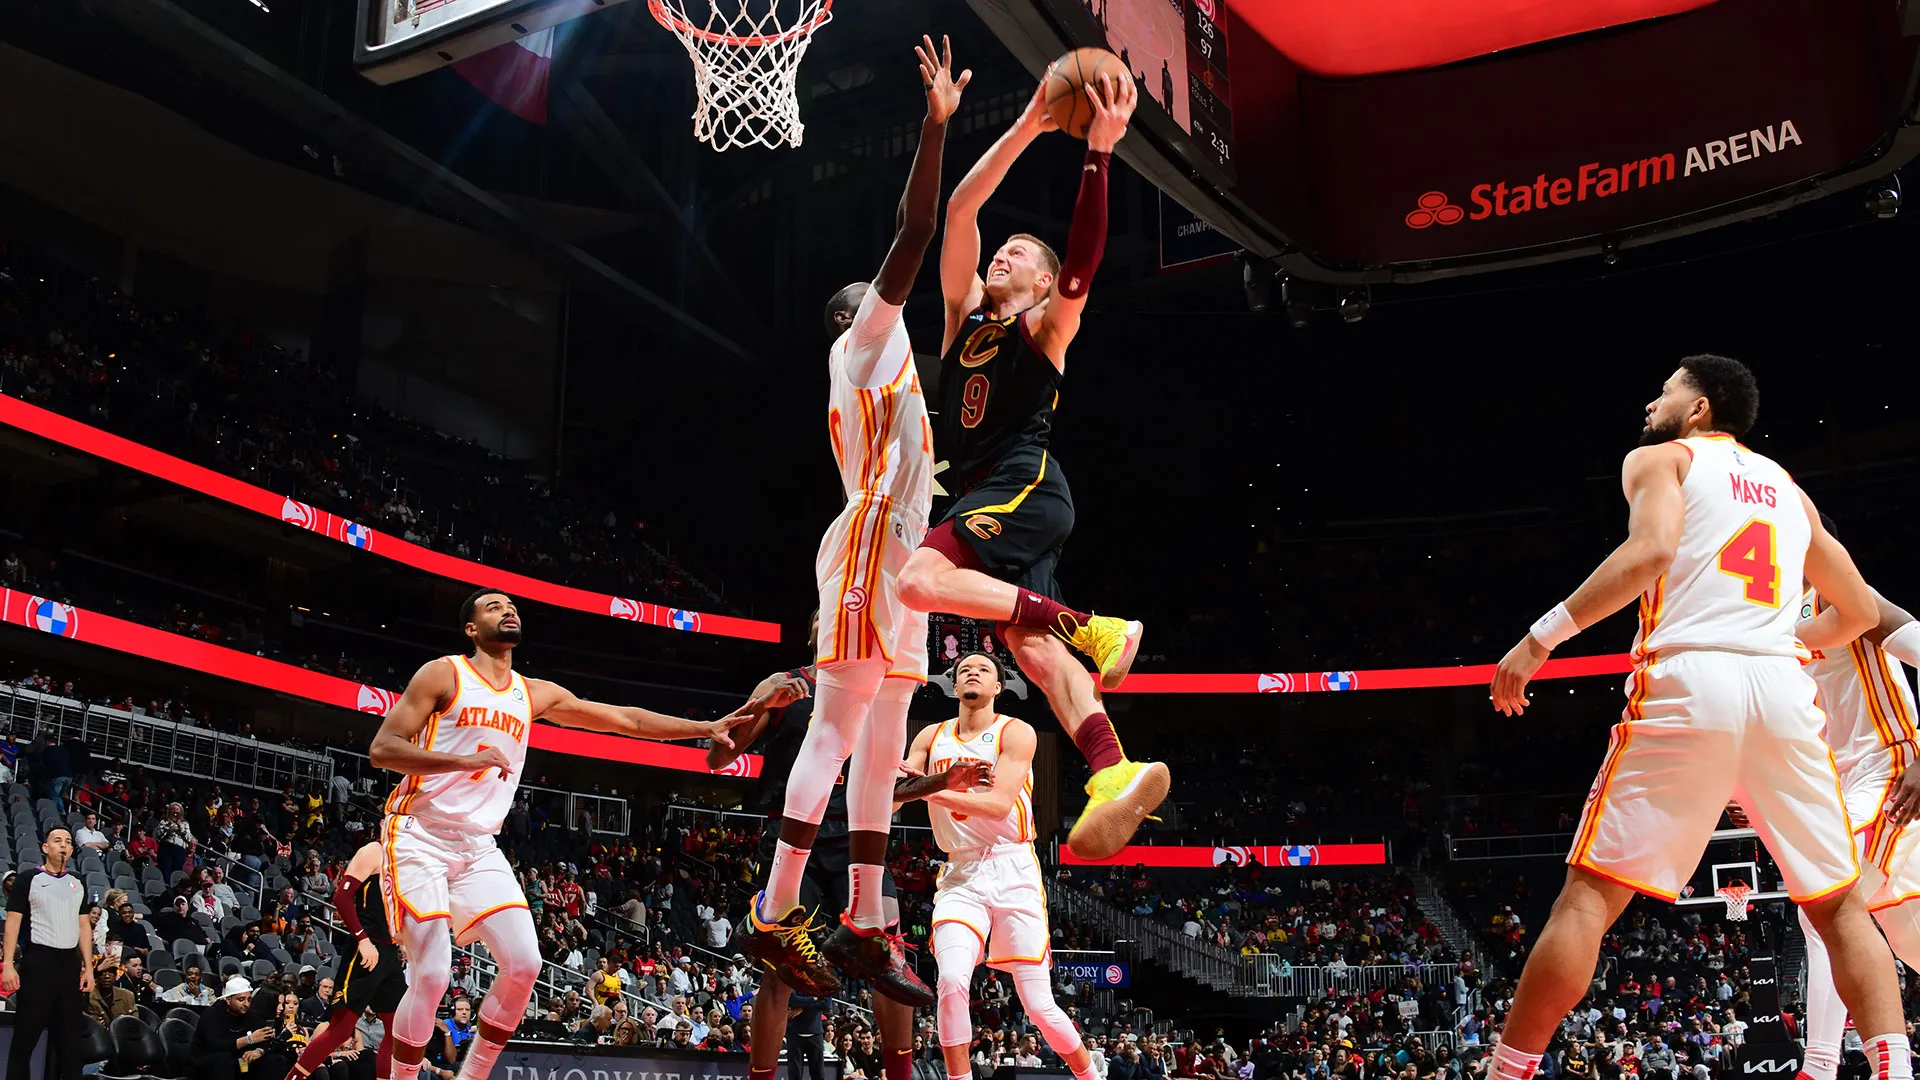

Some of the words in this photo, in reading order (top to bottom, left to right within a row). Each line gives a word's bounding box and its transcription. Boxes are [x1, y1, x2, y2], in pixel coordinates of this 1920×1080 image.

[1198, 12, 1214, 39] 126
[1200, 38, 1212, 58] 97
[1211, 132, 1230, 159] 2:31
[1684, 119, 1803, 177] ARENA
[1177, 220, 1213, 237] CHAMP
[961, 374, 990, 428] 9
[1729, 473, 1777, 509] MAYS
[1718, 517, 1782, 609] 4
[455, 707, 525, 744] ATLANTA
